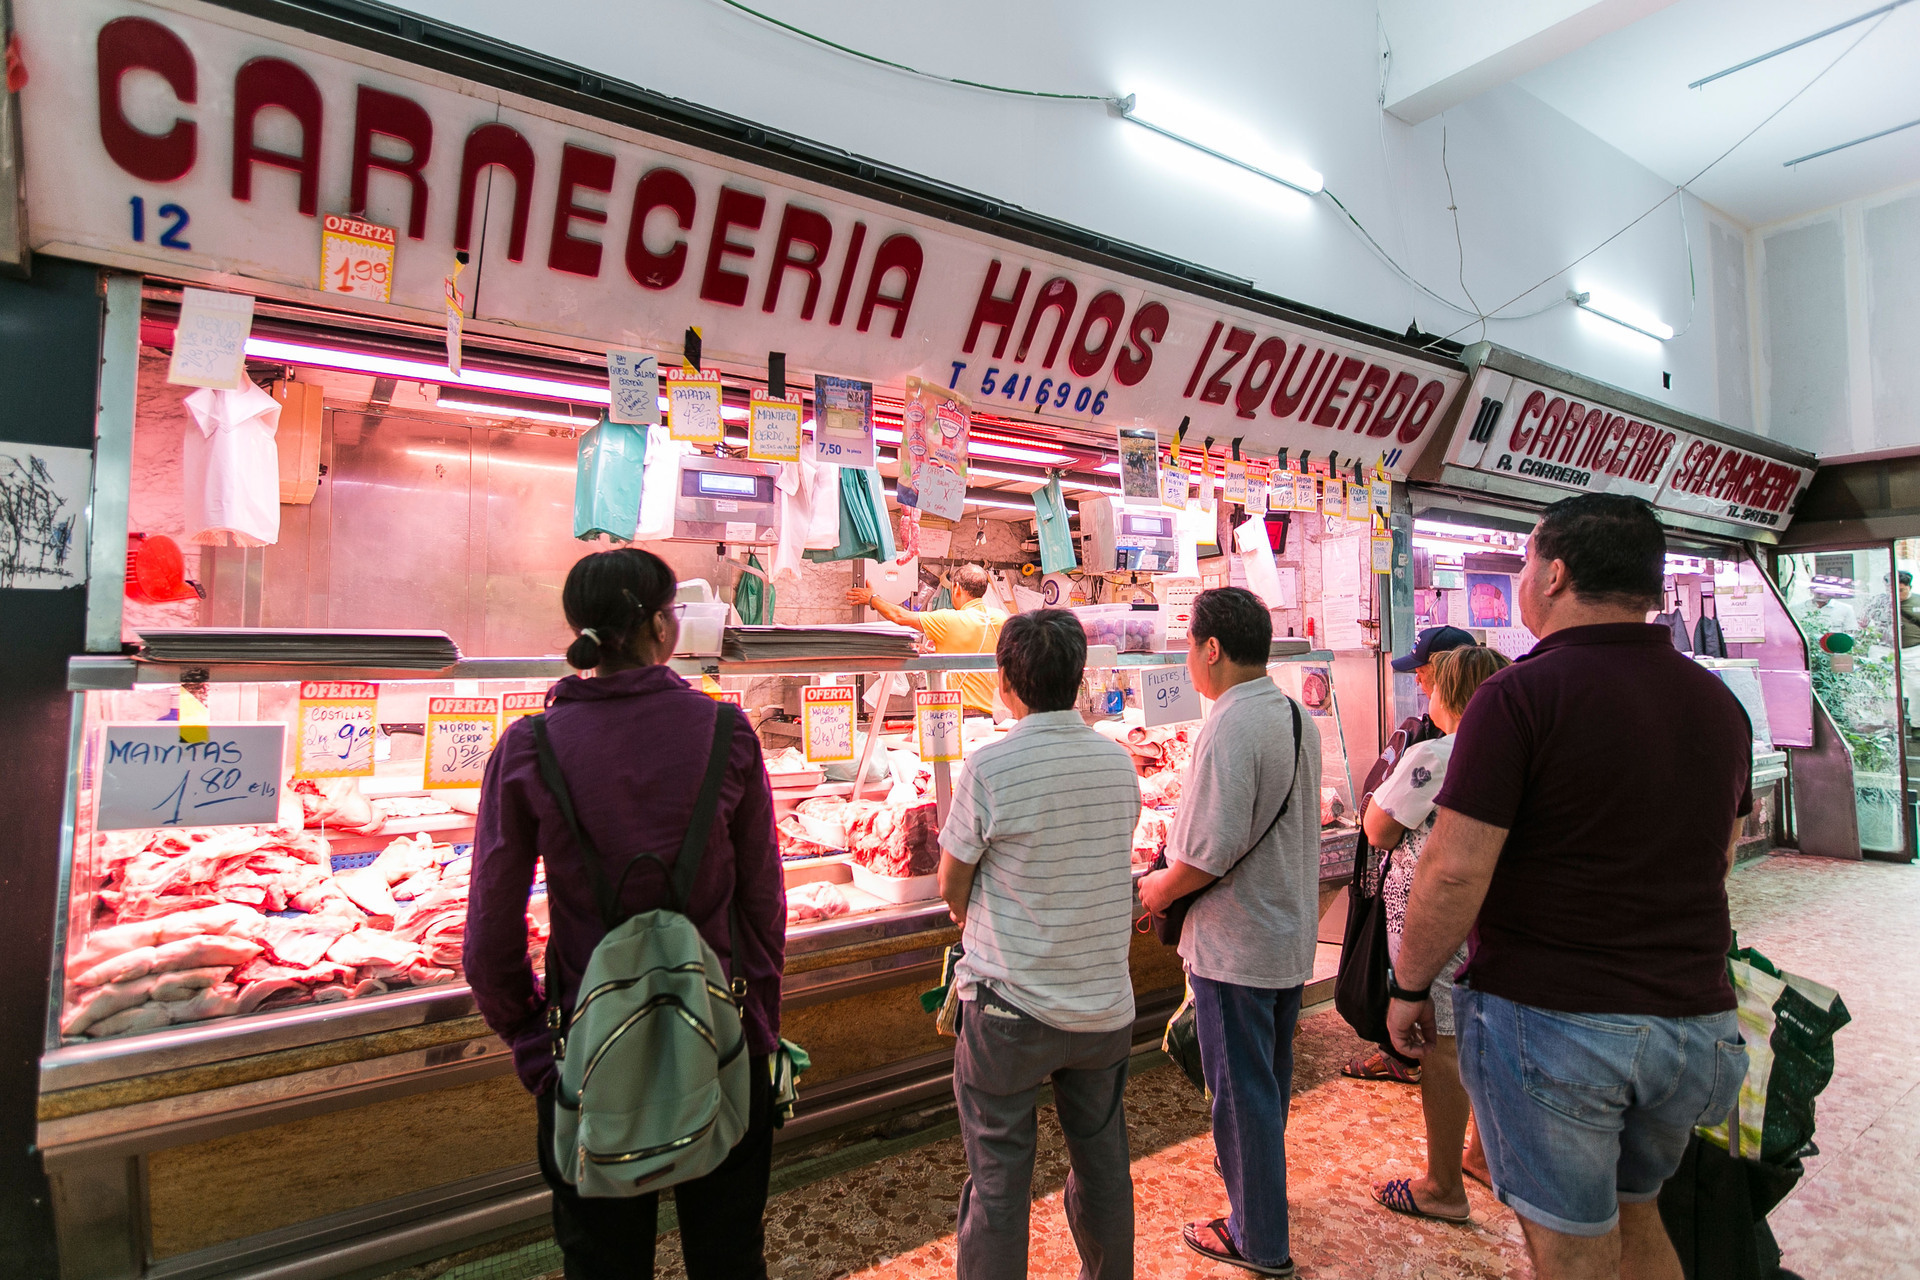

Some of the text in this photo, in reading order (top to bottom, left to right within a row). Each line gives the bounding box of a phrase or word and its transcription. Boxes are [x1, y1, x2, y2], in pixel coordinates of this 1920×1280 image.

[98, 15, 1446, 444] CARNECERIA HNOS IZQUIERDO
[130, 196, 190, 250] 12
[325, 216, 394, 242] OFERTA
[333, 257, 387, 293] 1.99
[827, 376, 863, 392] Oferta
[949, 361, 1109, 416] T 5416906
[674, 389, 711, 401] PAPADA
[753, 389, 801, 404] OFTA
[757, 409, 797, 421] MANTECA
[1469, 396, 1503, 443] 10
[754, 430, 784, 441] CERDO
[1509, 390, 1677, 485] CARNICERIA
[819, 442, 842, 456] 7,50
[1518, 458, 1591, 486] CARRERA
[1148, 671, 1180, 686] FILETES
[303, 684, 376, 698] OFERTA
[807, 688, 852, 700] OFERTA
[432, 699, 496, 713] OFERTA
[919, 693, 960, 705] OFERTA
[312, 708, 372, 721] COSTILLAS
[439, 723, 477, 734] MORRO
[452, 734, 483, 744] CERDO
[109, 740, 242, 765] MANITAS
